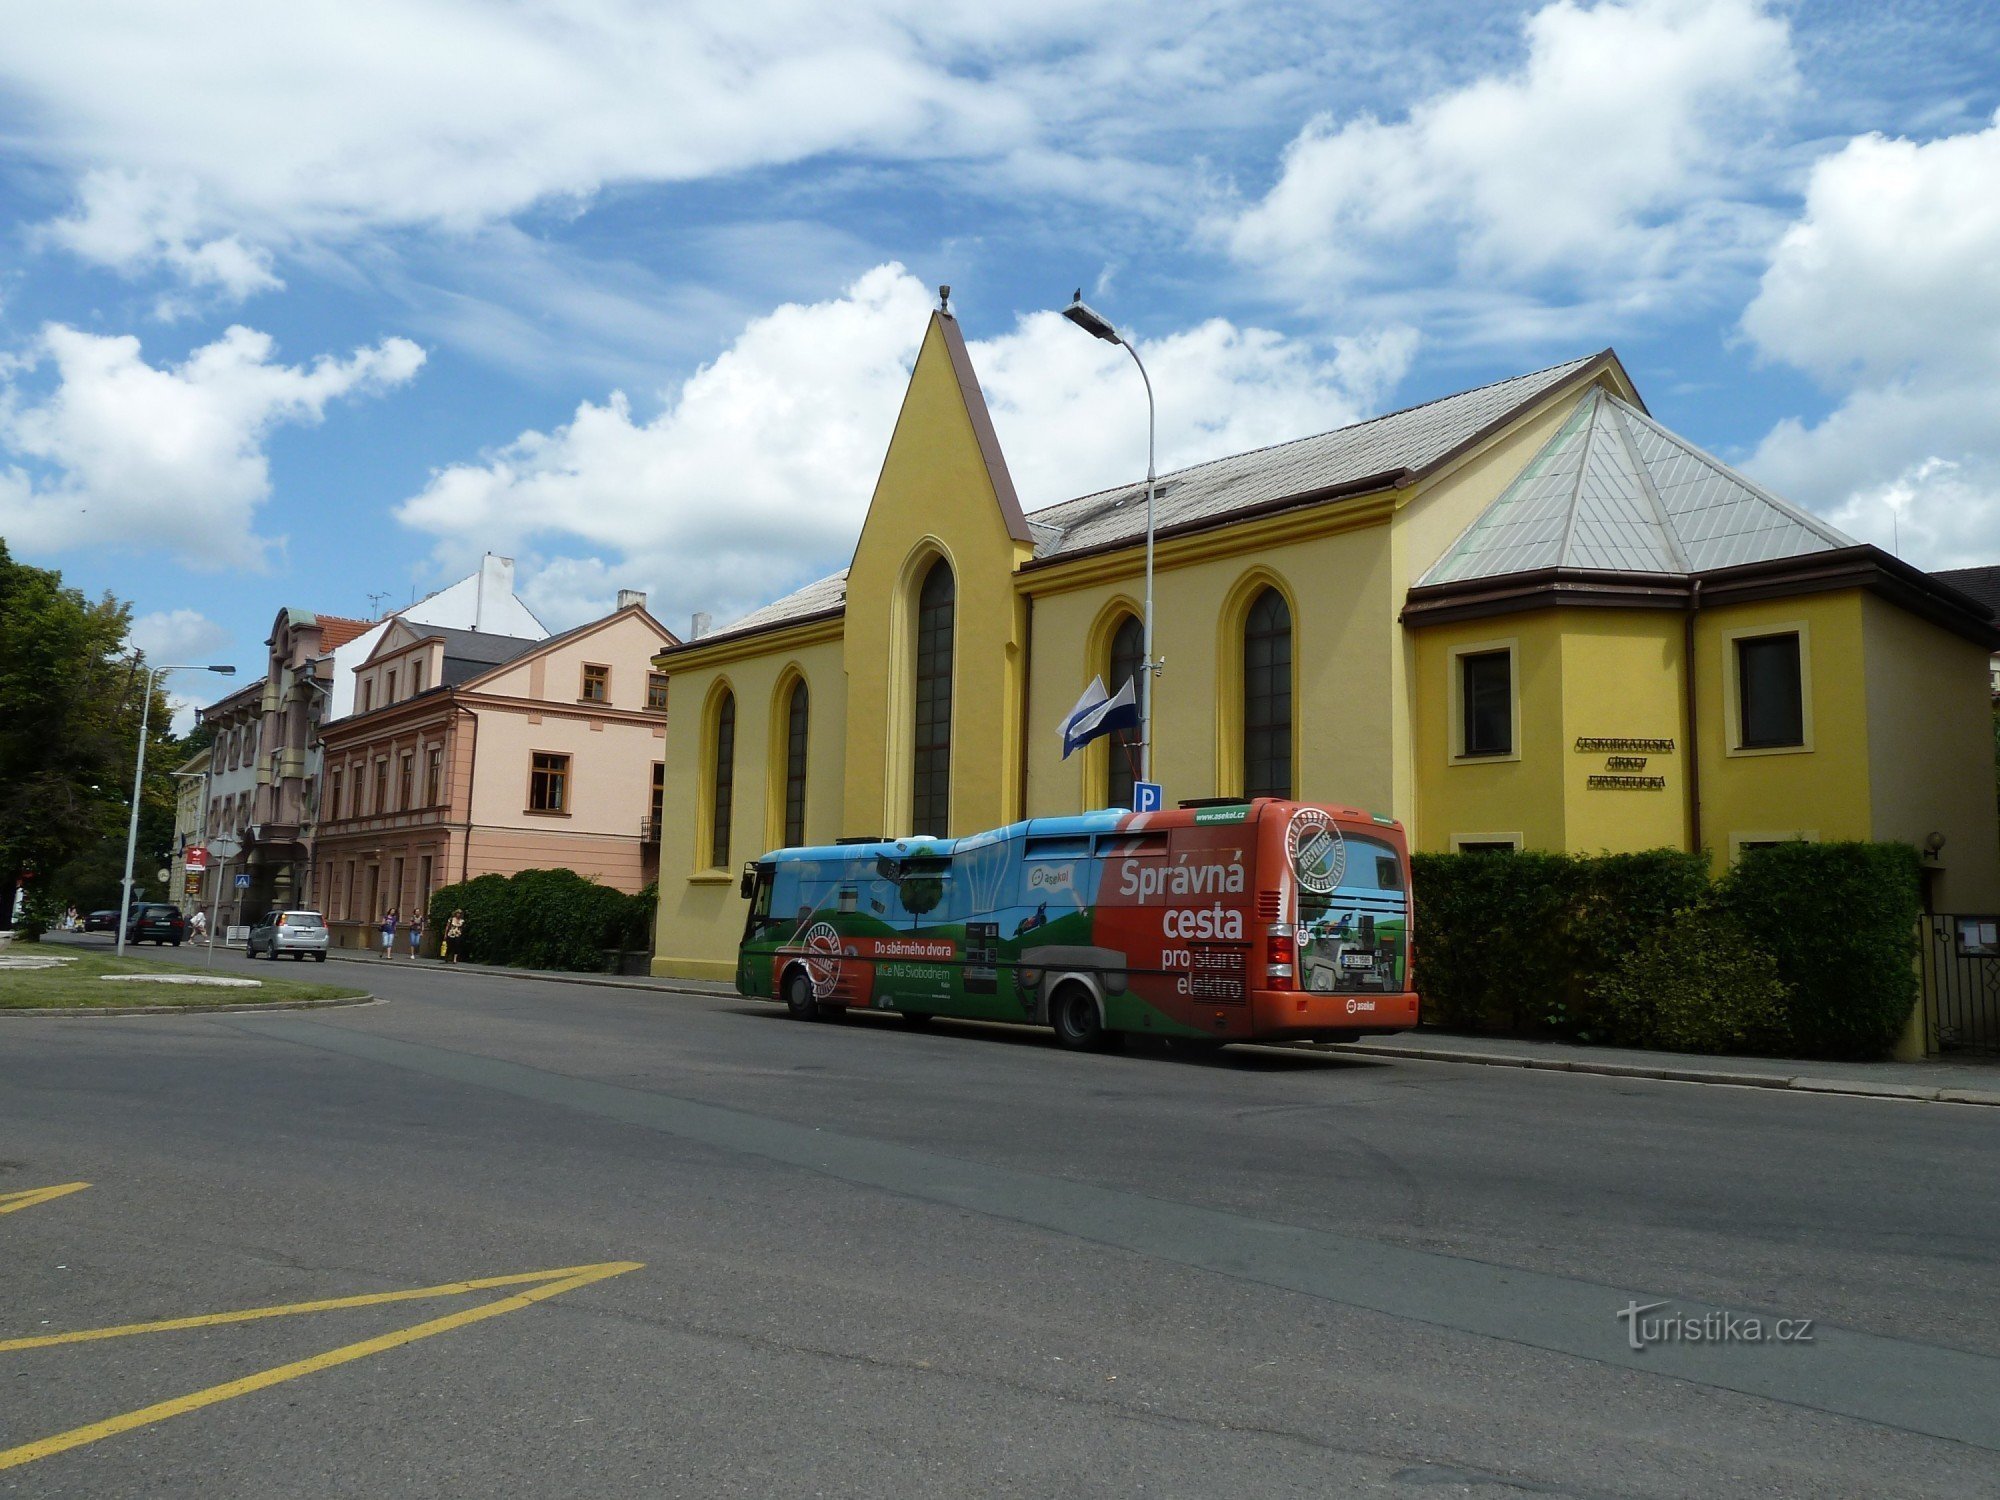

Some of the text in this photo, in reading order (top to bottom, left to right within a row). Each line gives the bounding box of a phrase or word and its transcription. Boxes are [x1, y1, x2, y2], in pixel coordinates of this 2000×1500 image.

[1141, 788, 1155, 812] P
[1196, 811, 1245, 821] www.asekol.cz
[1299, 831, 1332, 870] RECYKLACE
[1044, 870, 1069, 885] asekol
[1120, 851, 1245, 904] Správná
[1162, 901, 1242, 939] cesta
[874, 940, 951, 956] Do sběrného dvora
[1162, 949, 1190, 970] pro
[893, 964, 904, 977] Na
[1357, 1001, 1376, 1011] asekol
